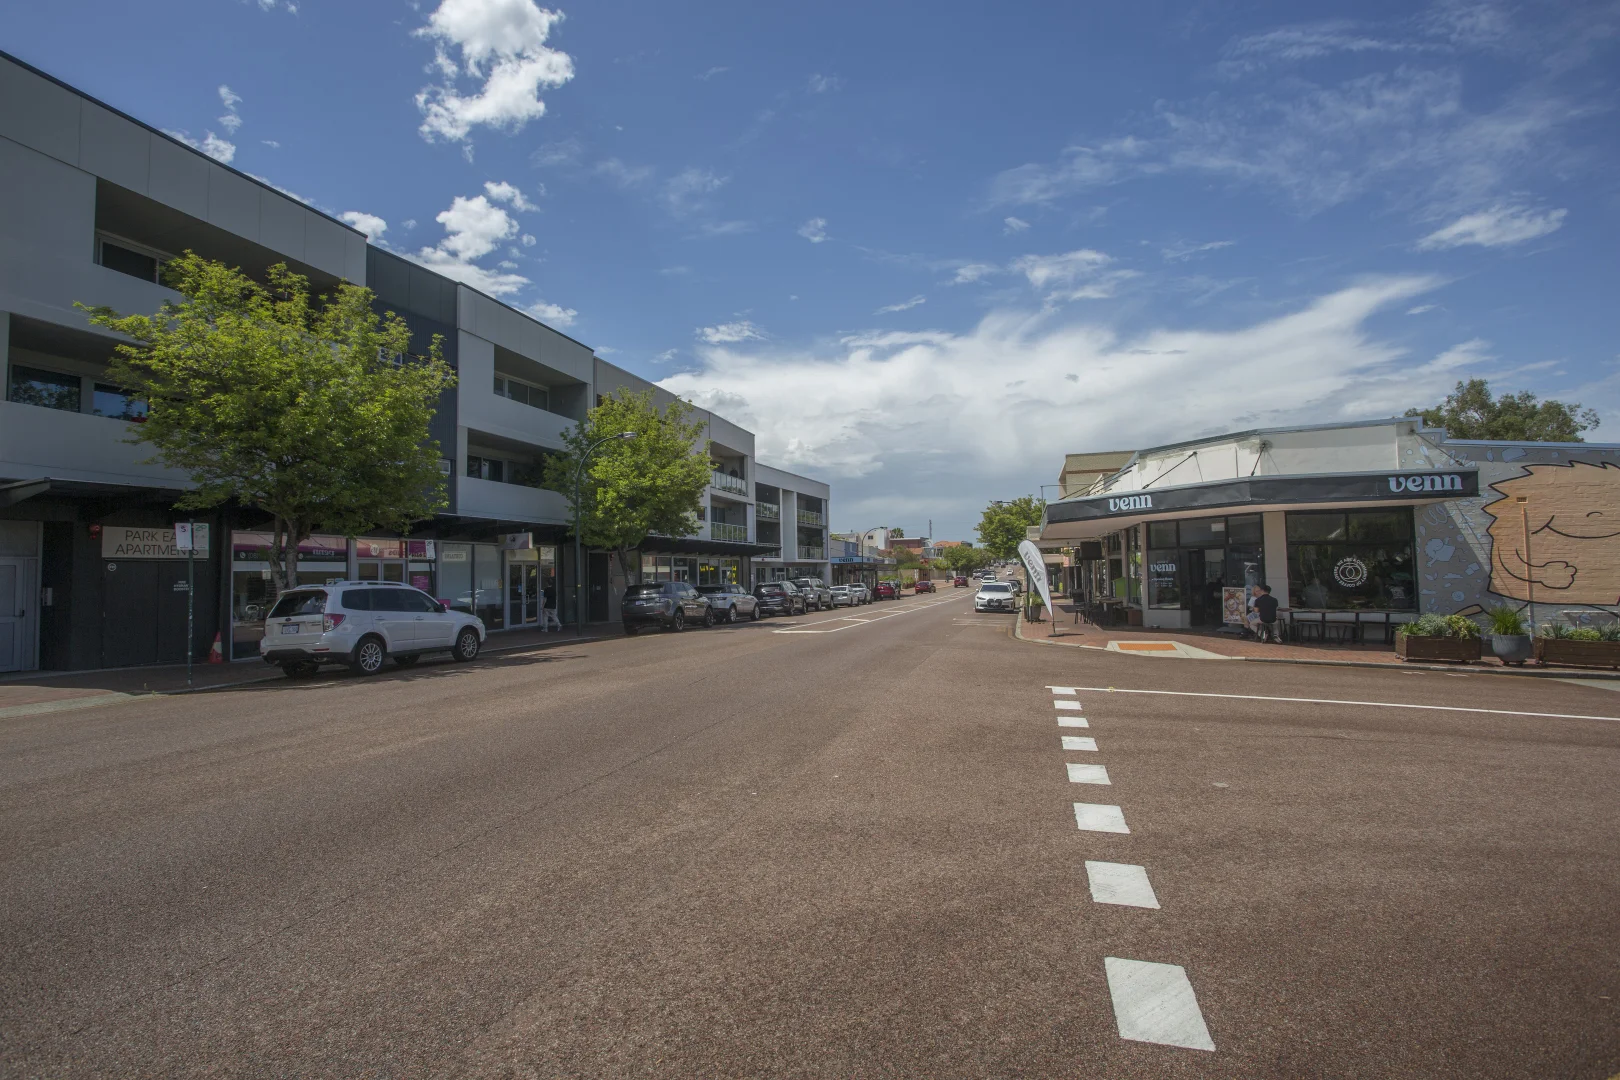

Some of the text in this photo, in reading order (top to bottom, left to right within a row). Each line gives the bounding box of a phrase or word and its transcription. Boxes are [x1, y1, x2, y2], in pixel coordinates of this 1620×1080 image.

[1389, 474, 1463, 493] venn
[1108, 494, 1152, 512] venn
[125, 529, 158, 542] PARK
[115, 544, 199, 556] APARTMENS
[1024, 550, 1042, 582] venn
[1150, 561, 1176, 572] venn
